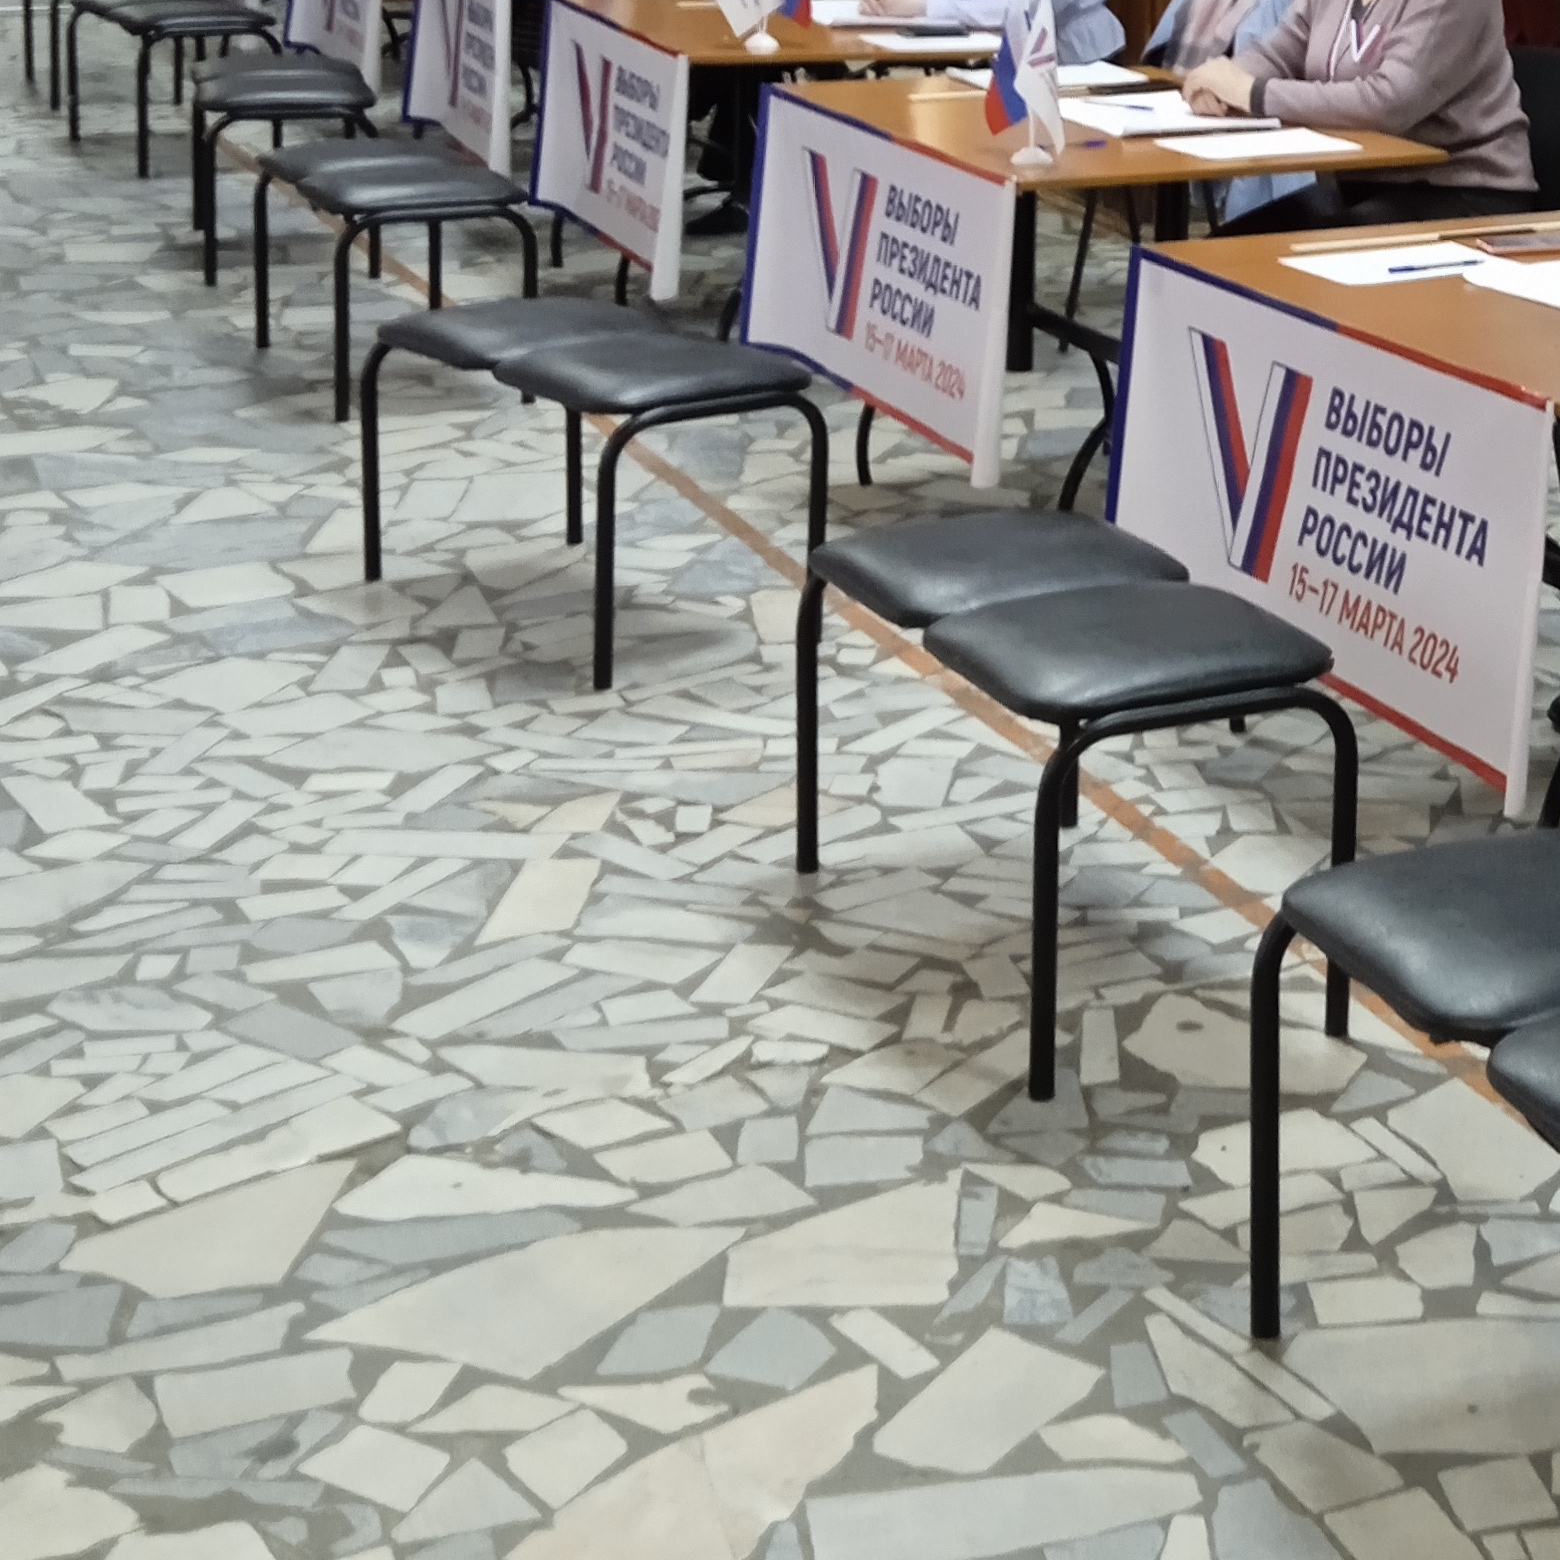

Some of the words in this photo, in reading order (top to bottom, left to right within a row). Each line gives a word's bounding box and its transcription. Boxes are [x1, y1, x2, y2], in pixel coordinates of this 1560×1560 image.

[885, 184, 959, 245] ВЫБОРЫ
[869, 278, 935, 338] РОССИИ
[877, 231, 981, 311] ПРЕЗИДЕНТА
[1325, 386, 1451, 477] ВЫБОРЫ
[1298, 505, 1406, 595] РОССИИ
[1312, 446, 1489, 567] ПРЕЗИДЕНТА
[1339, 591, 1405, 654] МАРТА
[1408, 626, 1459, 684] 2024
